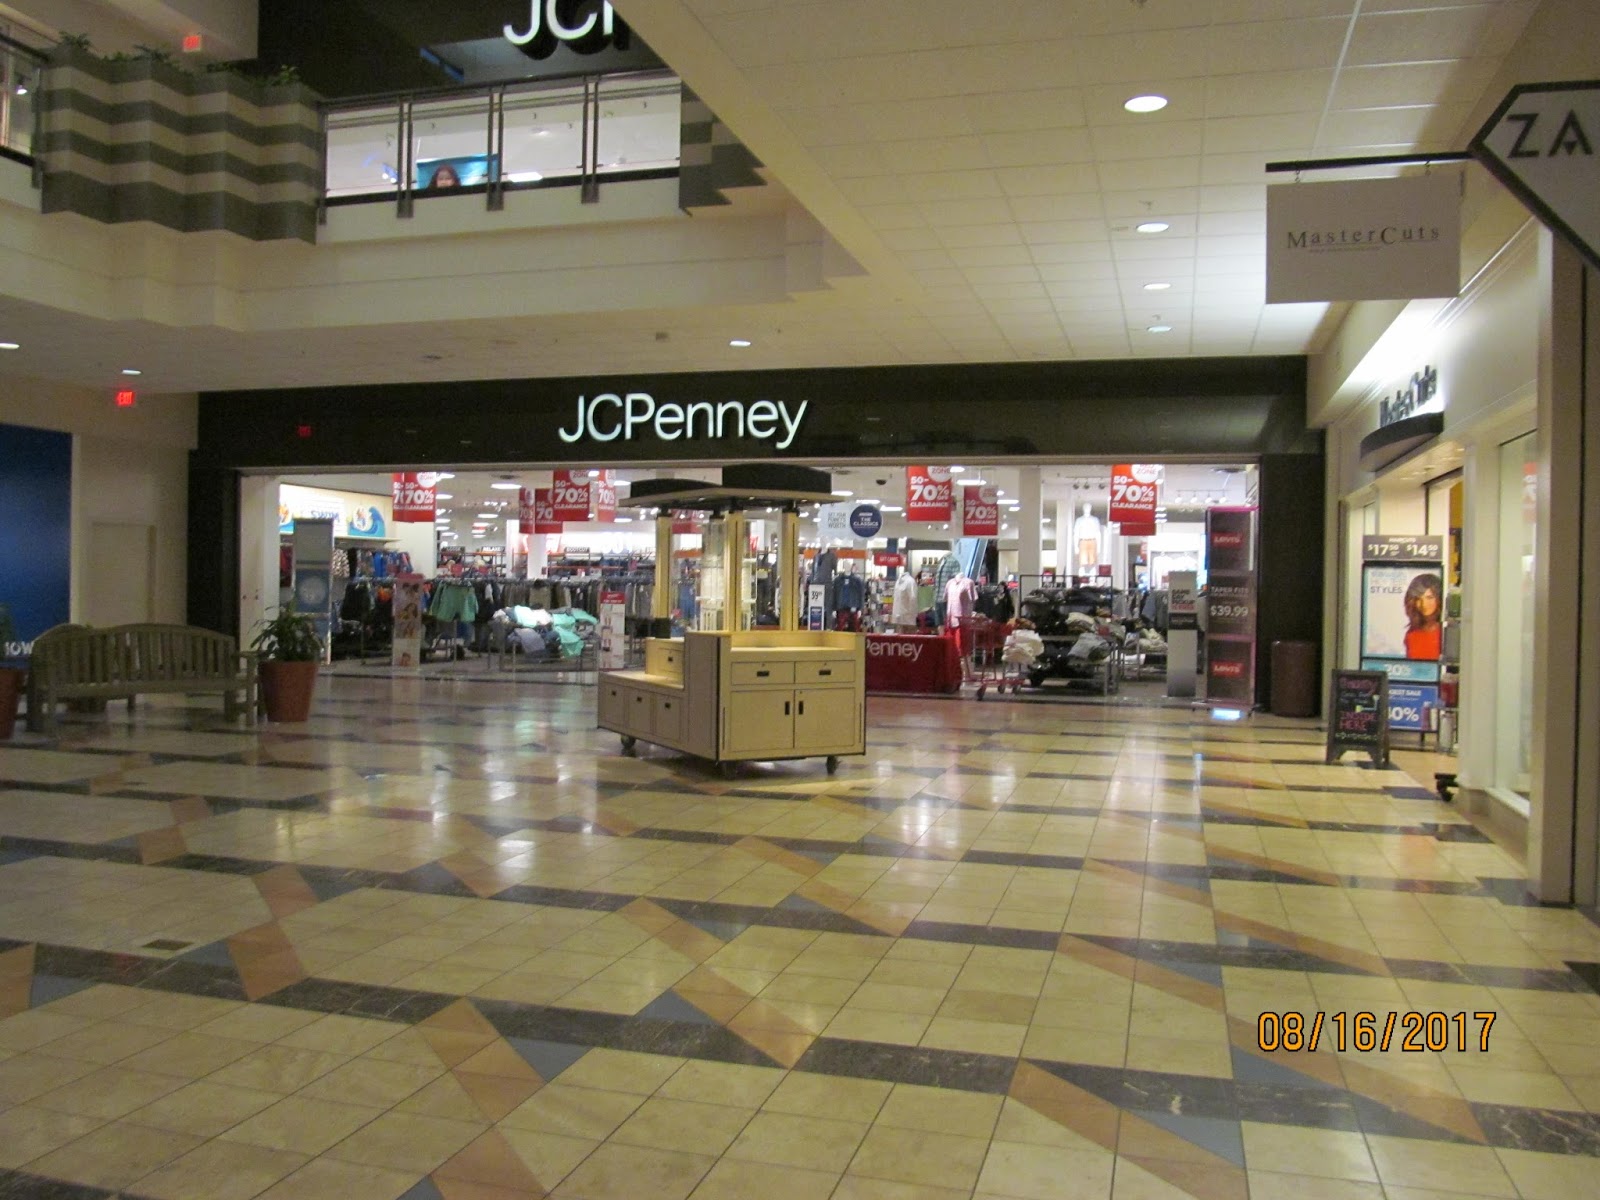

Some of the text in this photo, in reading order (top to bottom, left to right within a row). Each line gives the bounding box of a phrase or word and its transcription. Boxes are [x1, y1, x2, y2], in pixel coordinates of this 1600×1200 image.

[1287, 226, 1439, 249] MasterCuts
[558, 393, 808, 450] JCPenney
[554, 487, 588, 503] 70%
[911, 484, 950, 501] 70%
[1112, 484, 1155, 502] 70%
[1370, 586, 1403, 594] STYLES
[1210, 605, 1249, 617] $39.99
